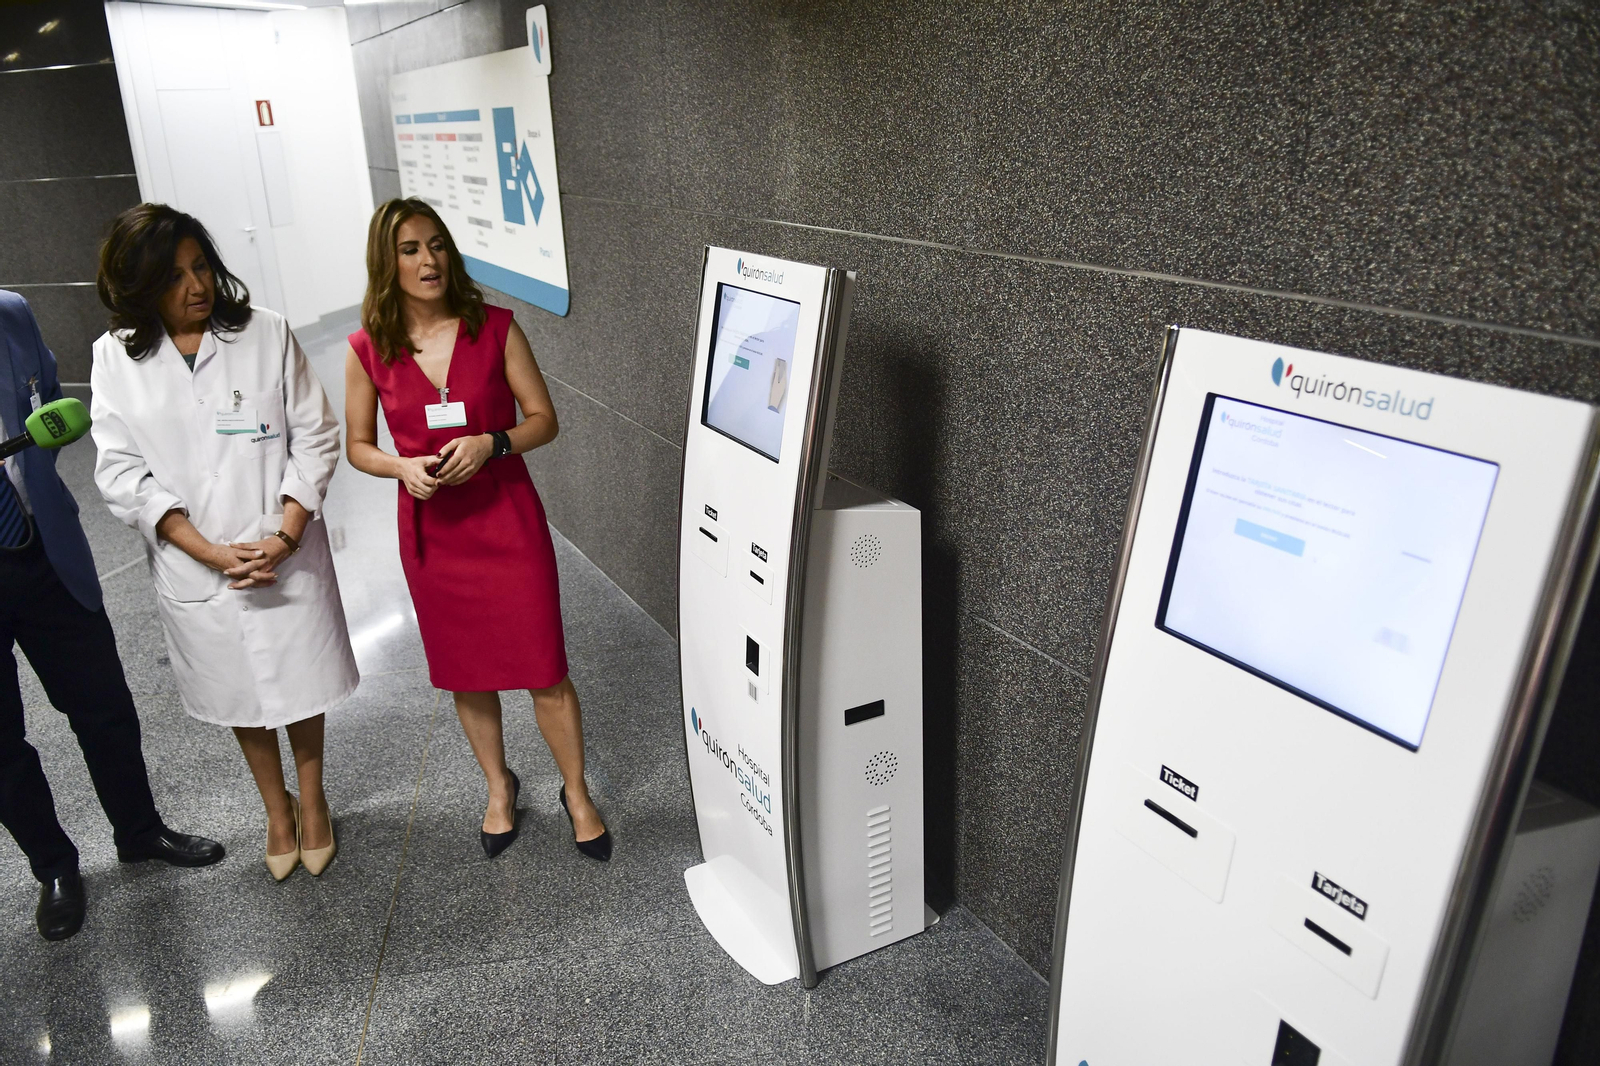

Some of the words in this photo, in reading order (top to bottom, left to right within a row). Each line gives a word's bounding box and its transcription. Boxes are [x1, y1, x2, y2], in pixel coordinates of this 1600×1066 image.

[742, 264, 785, 285] quirónsalud
[1289, 372, 1434, 421] quirónsalud
[1228, 418, 1283, 439] quirónsalud
[706, 506, 717, 520] Ticket
[752, 544, 767, 560] Tarjeta
[701, 729, 771, 814] quirónsalud
[737, 743, 770, 787] Hospital
[1162, 768, 1197, 799] Ticket
[740, 792, 773, 836] Córdoba
[1314, 873, 1366, 917] Tarjeta
